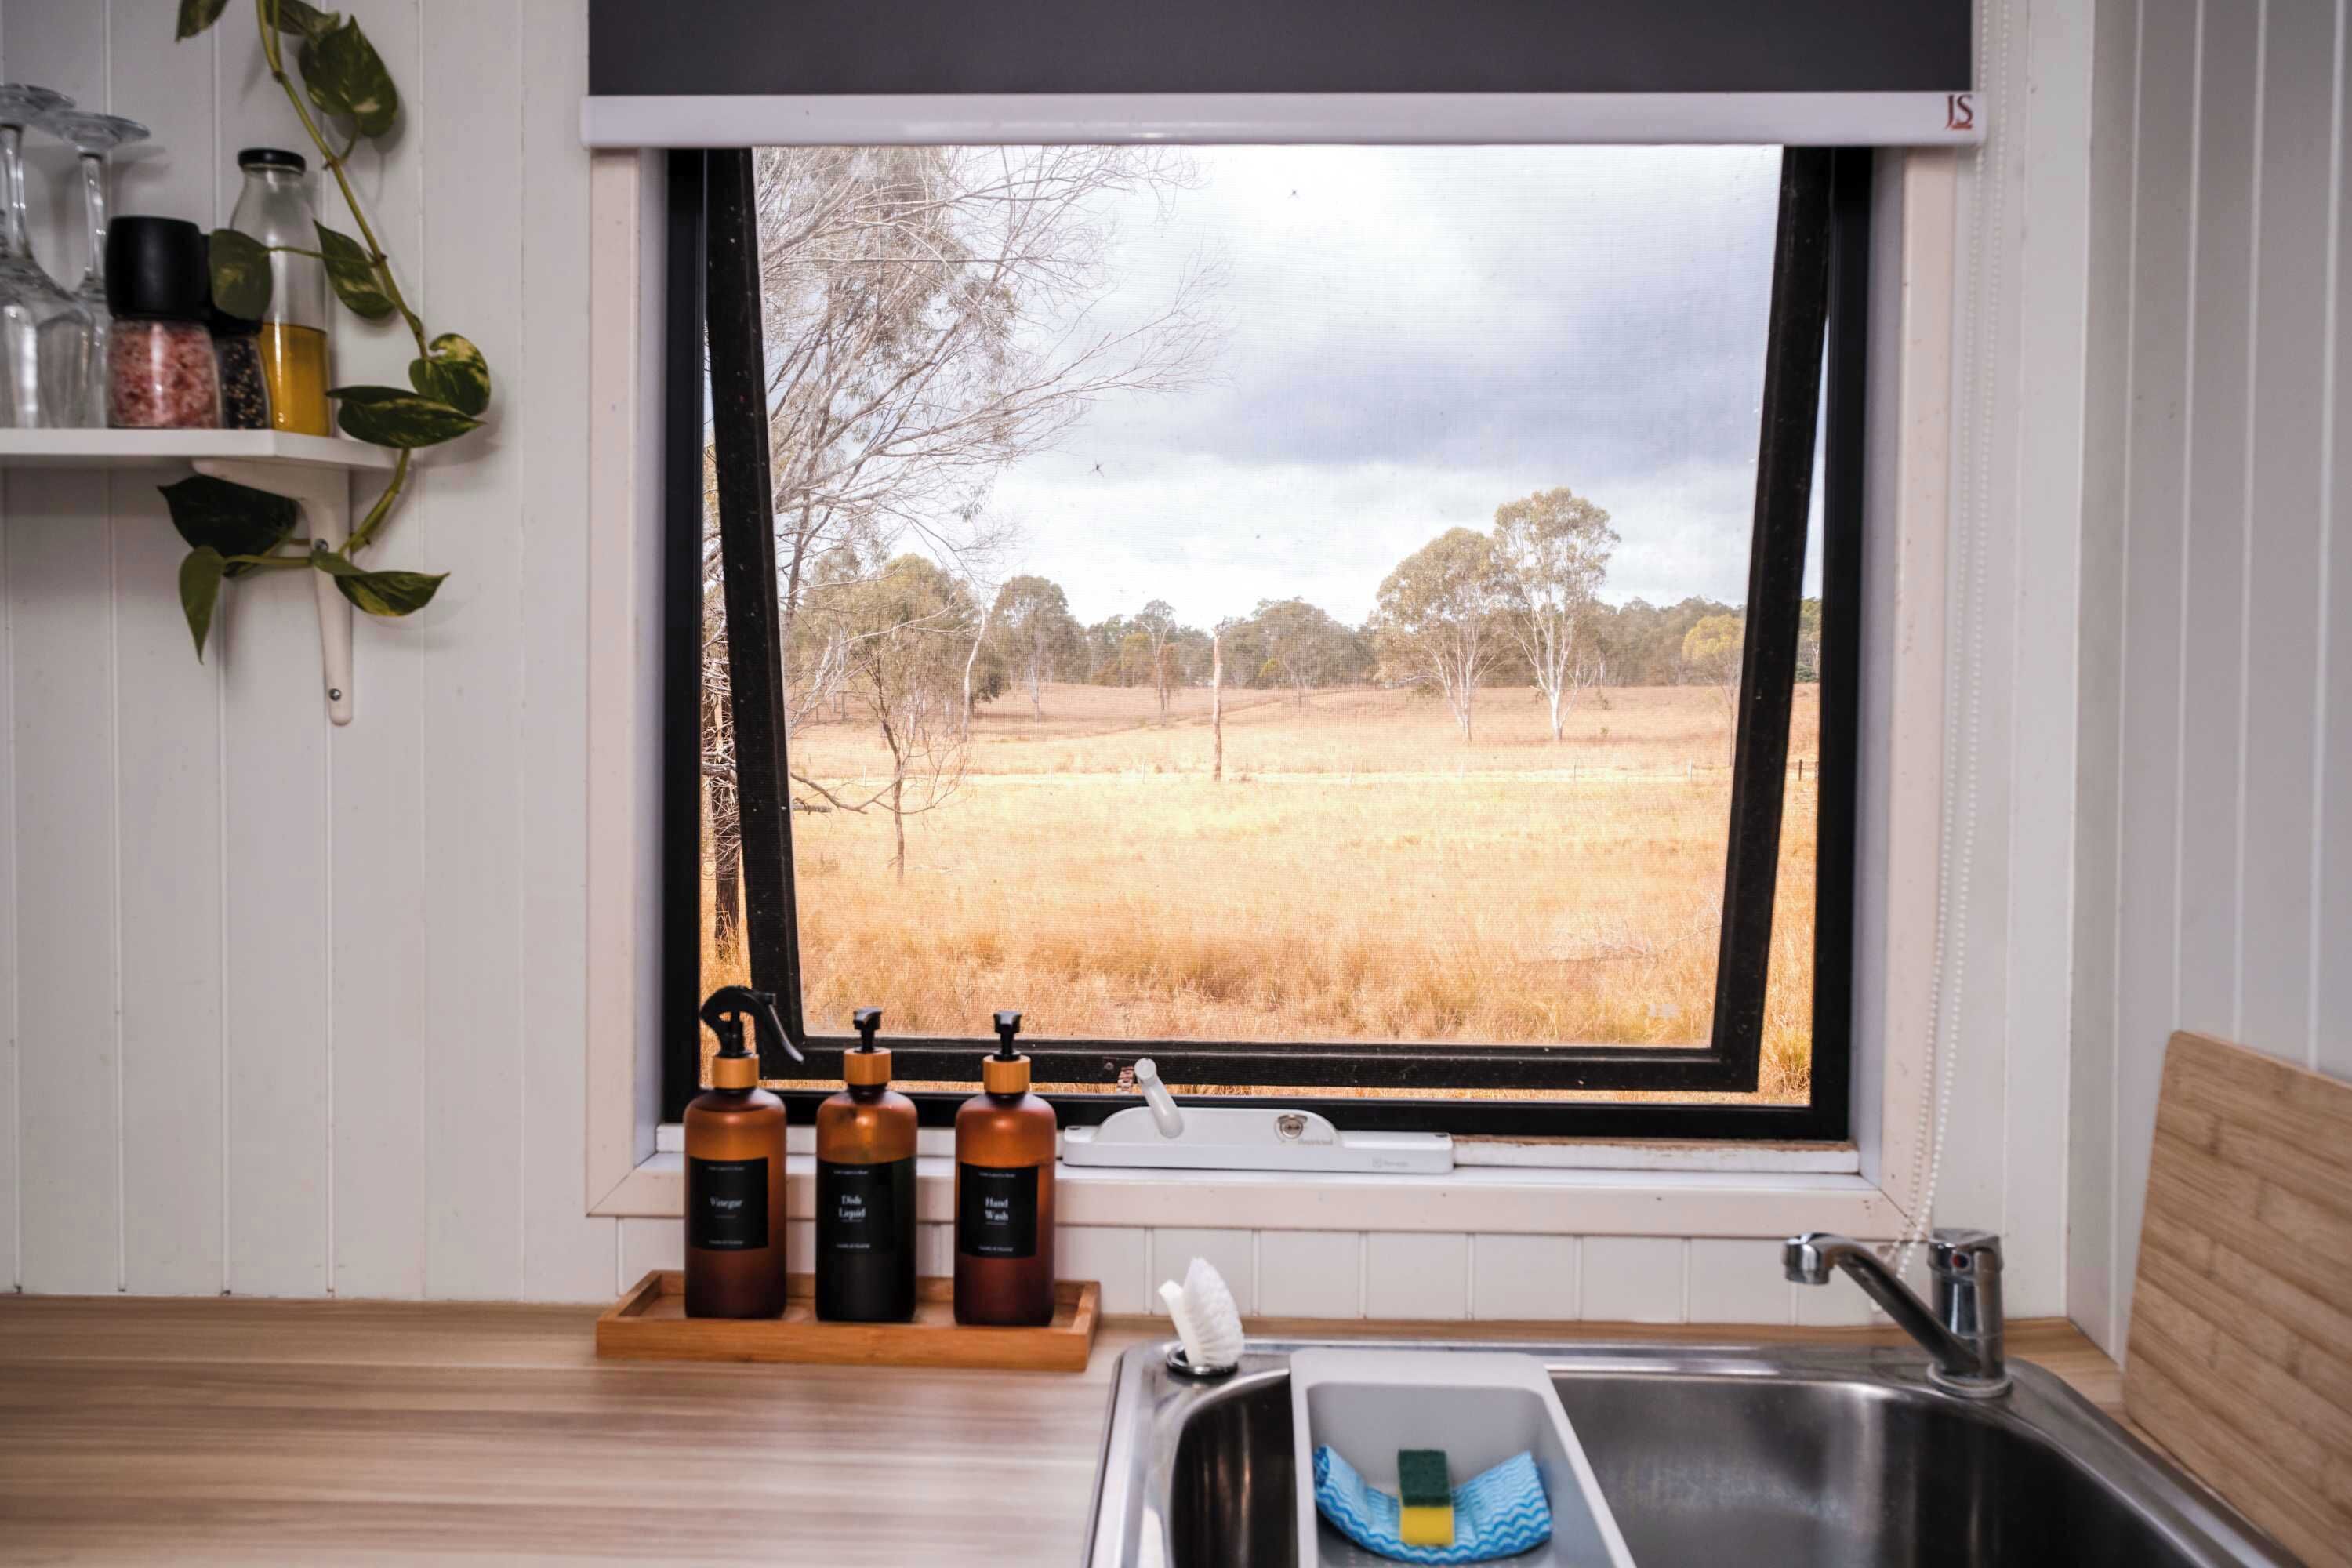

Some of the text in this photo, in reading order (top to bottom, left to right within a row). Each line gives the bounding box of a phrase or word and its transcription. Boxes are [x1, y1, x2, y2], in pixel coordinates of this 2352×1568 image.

[841, 1194, 862, 1205] Dish
[985, 1197, 1009, 1208] Hand
[838, 1207, 866, 1221] Liquid
[984, 1210, 1009, 1221] Wash
